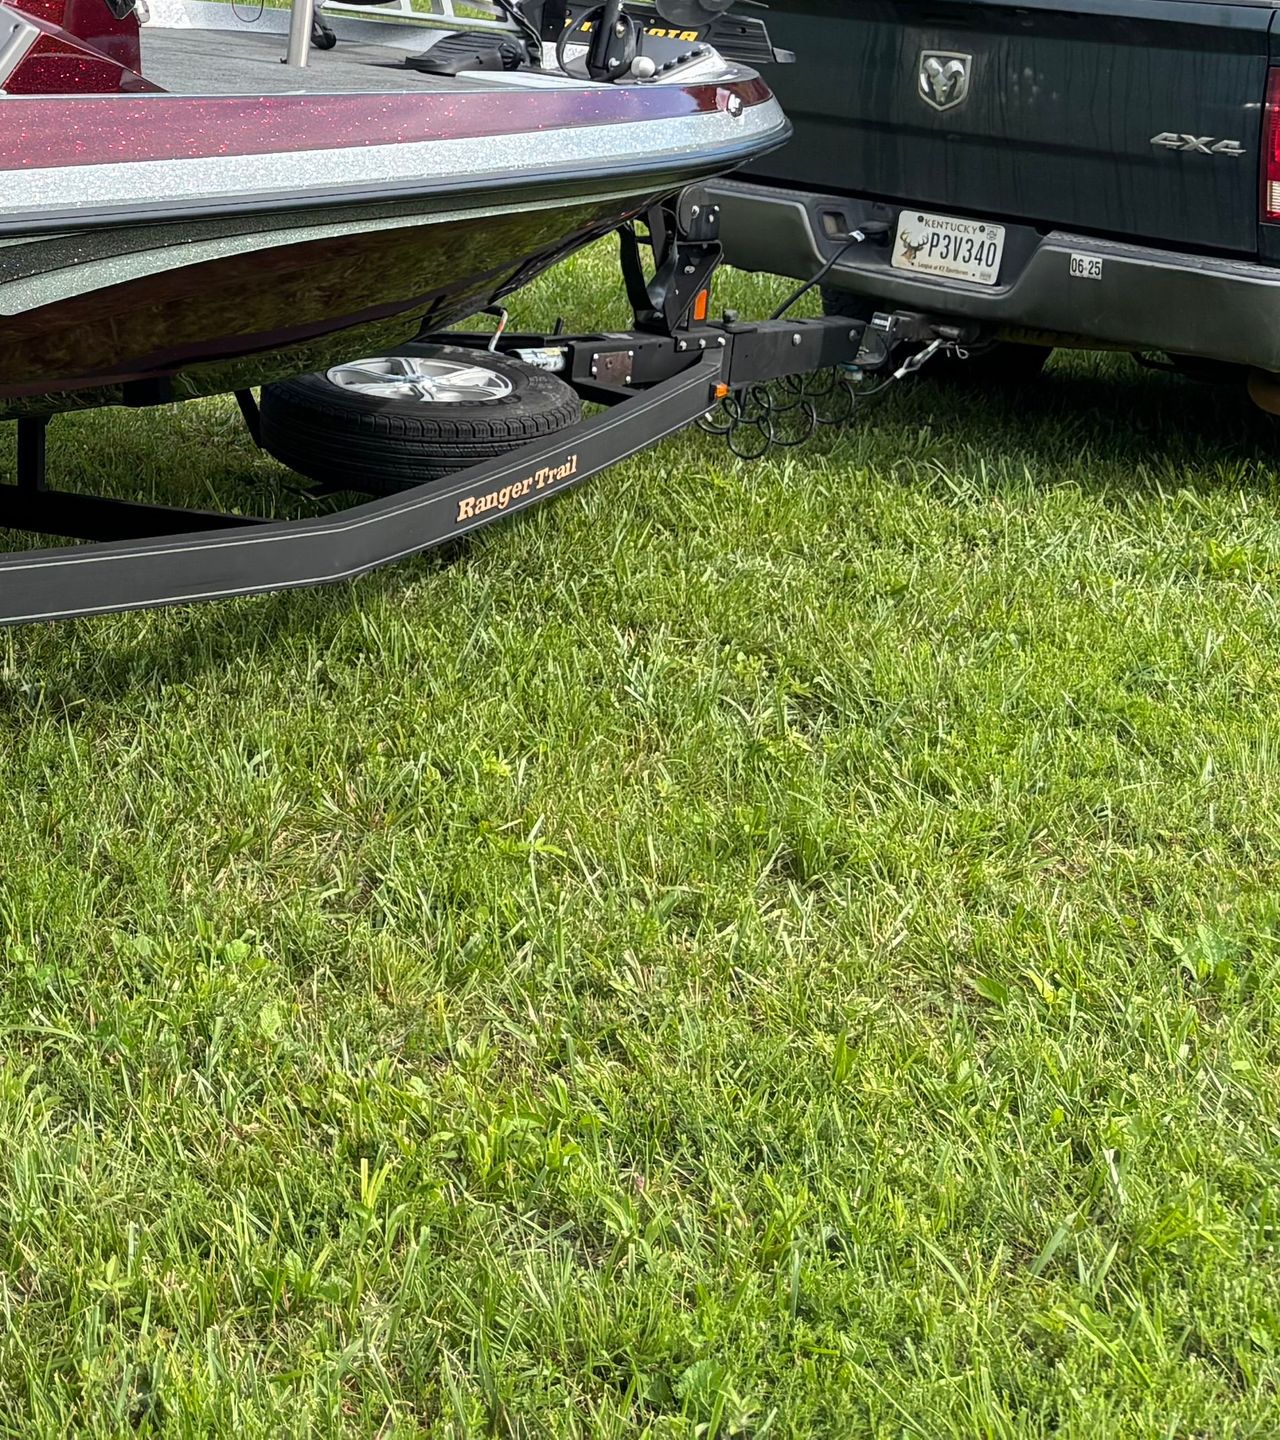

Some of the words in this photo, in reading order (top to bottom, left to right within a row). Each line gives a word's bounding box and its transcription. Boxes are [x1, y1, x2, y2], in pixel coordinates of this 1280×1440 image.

[643, 27, 699, 42] OTA
[924, 218, 978, 235] KENTUCKY
[928, 232, 997, 267] P3V340
[456, 476, 533, 522] Ranger
[534, 454, 577, 489] Trail
